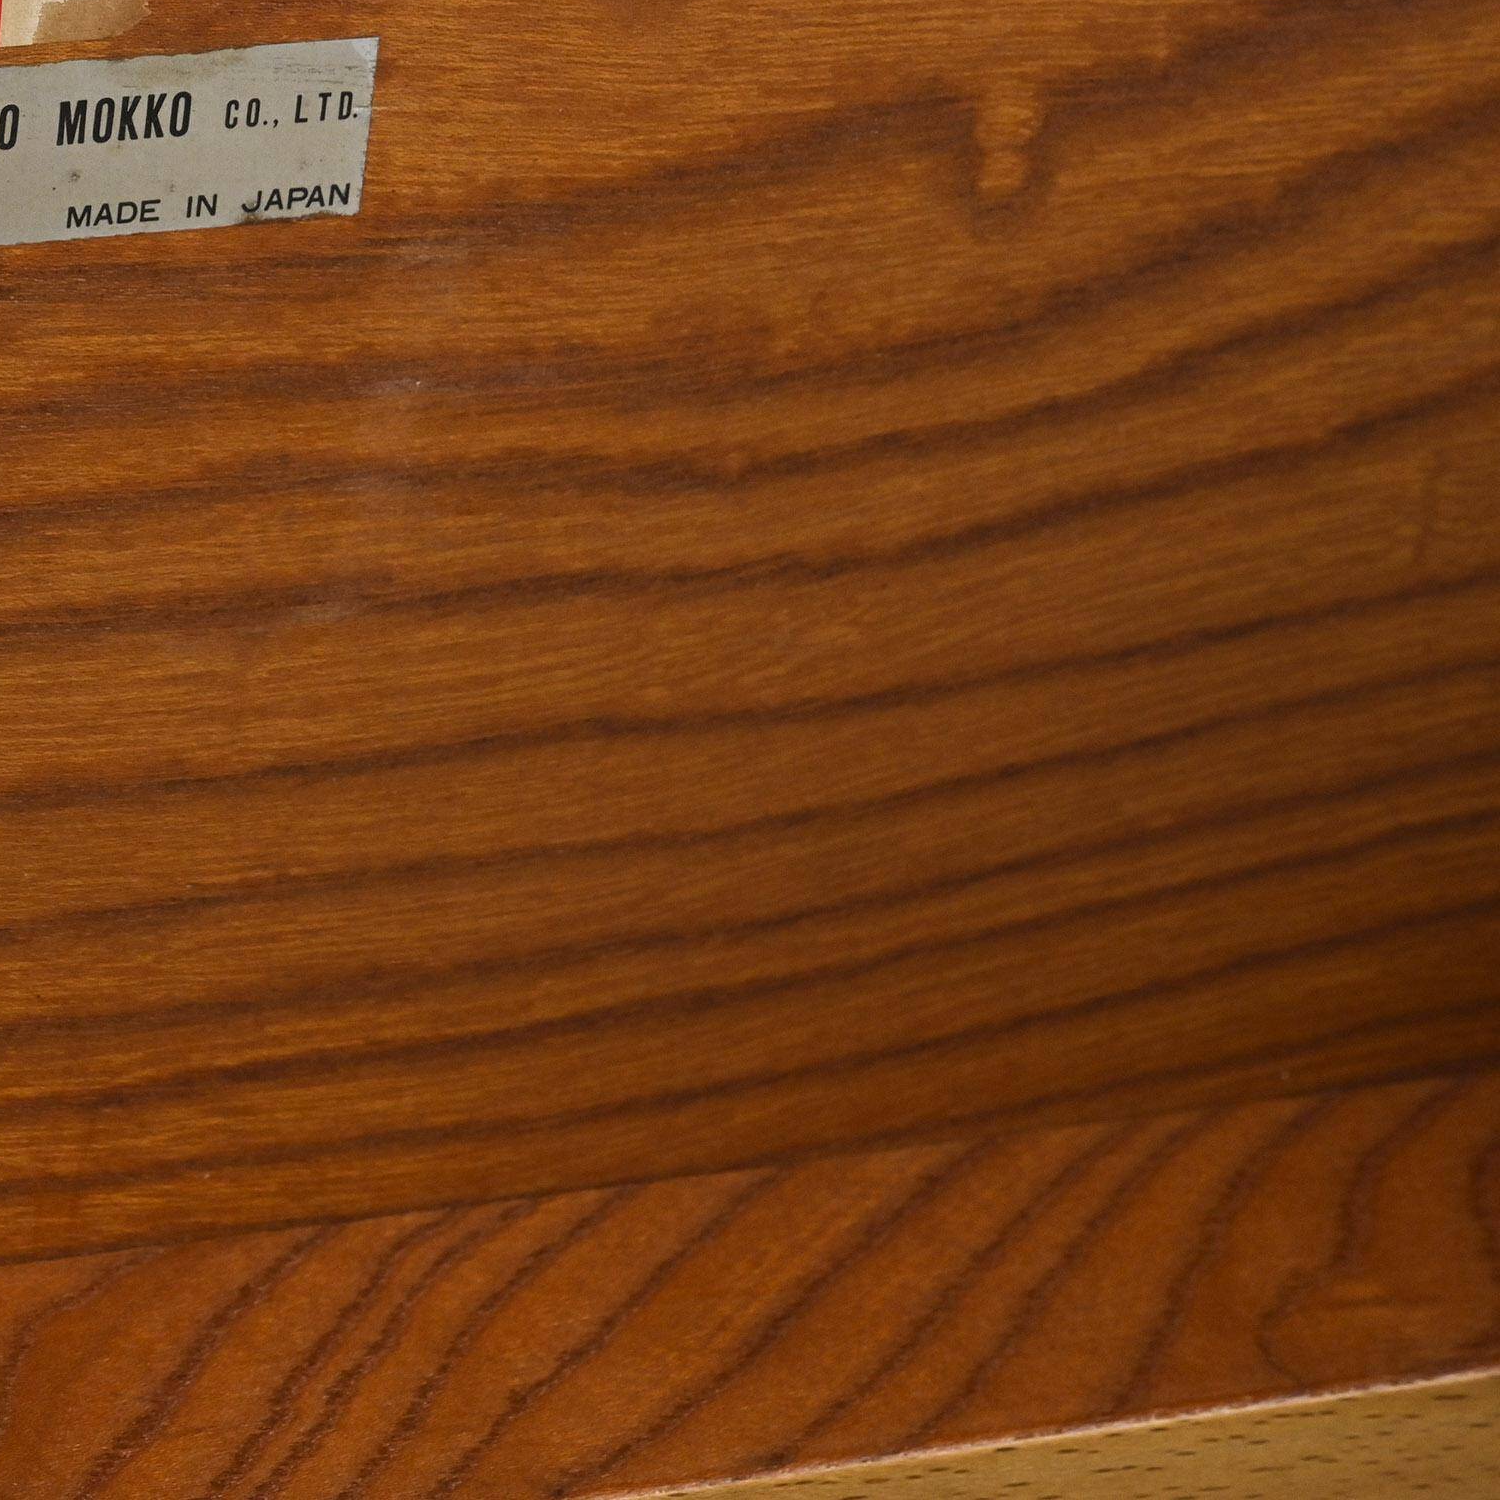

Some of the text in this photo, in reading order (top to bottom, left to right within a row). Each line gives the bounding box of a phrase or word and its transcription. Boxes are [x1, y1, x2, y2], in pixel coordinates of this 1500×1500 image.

[56, 91, 193, 146] MOKKO
[224, 98, 279, 129] CO.,
[294, 91, 358, 123] LTD.
[66, 182, 351, 229] MADE IN JAPAN
